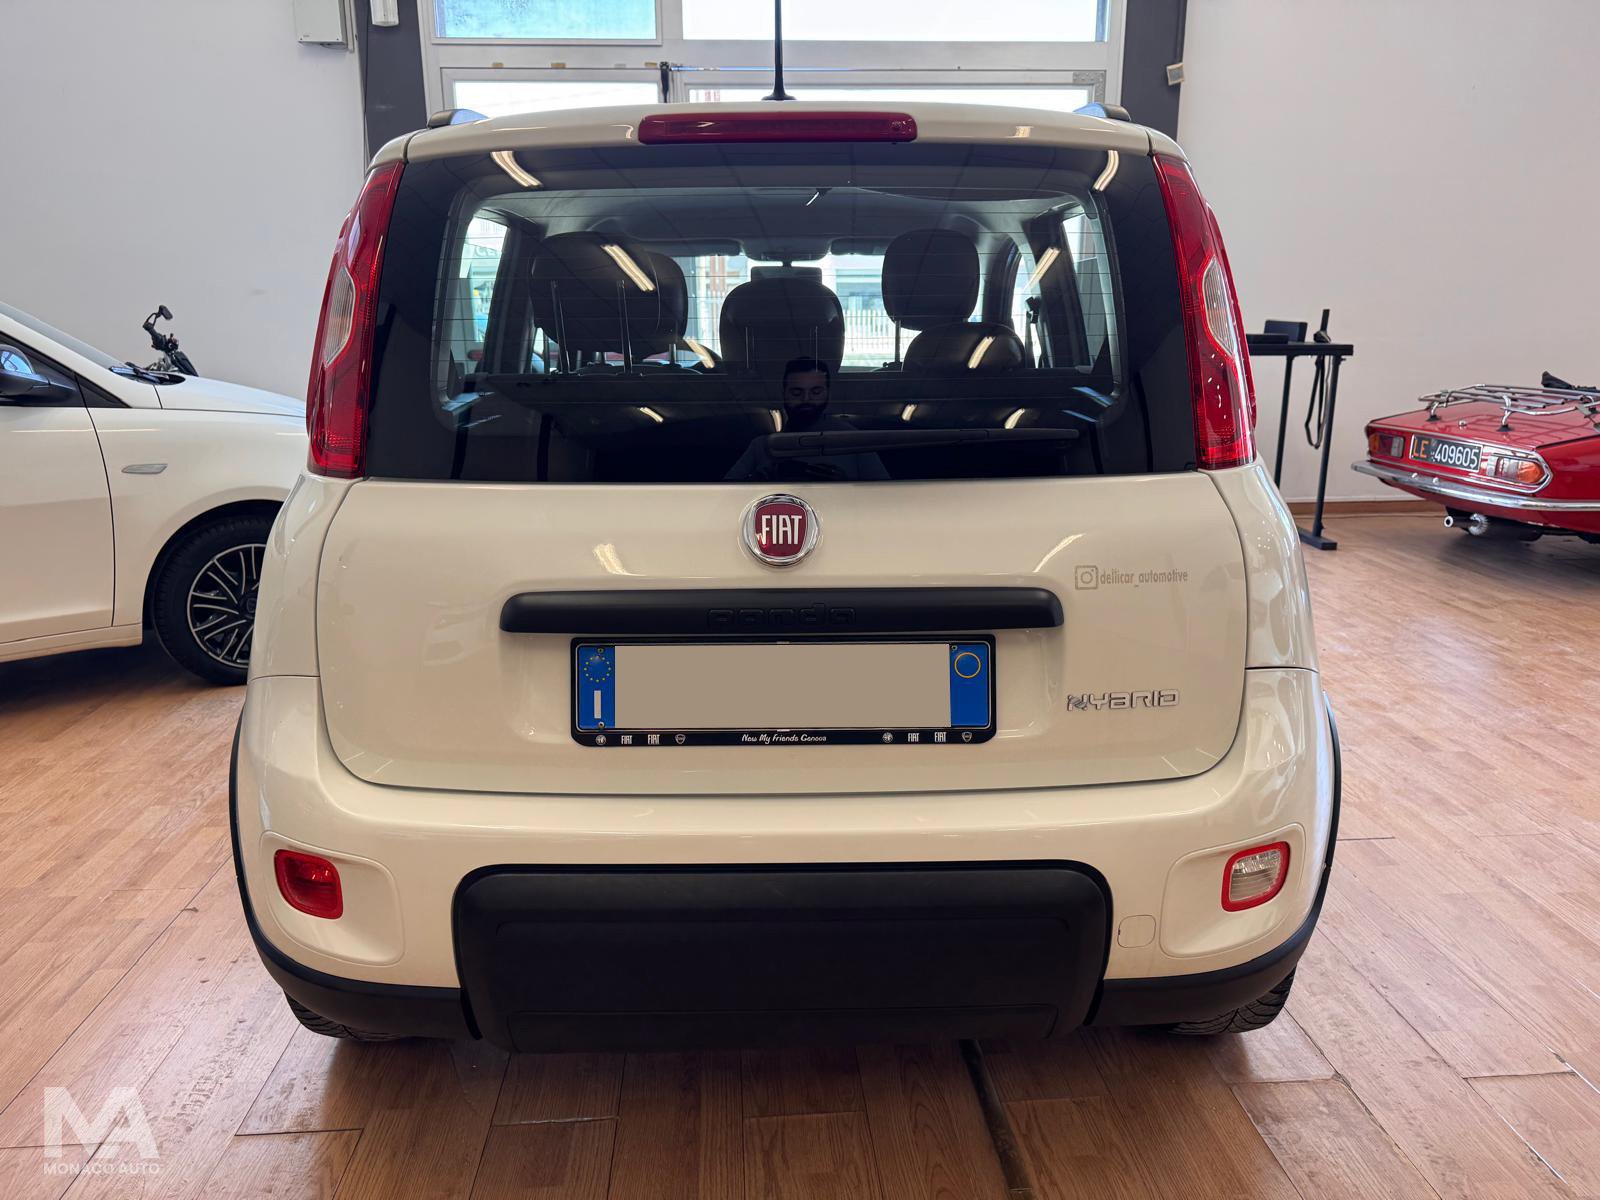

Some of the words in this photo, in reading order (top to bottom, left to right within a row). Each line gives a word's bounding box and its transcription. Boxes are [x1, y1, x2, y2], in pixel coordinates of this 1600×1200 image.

[1413, 438, 1429, 458] LE
[1434, 443, 1480, 469] 409605
[761, 514, 803, 545] FIAT
[1067, 689, 1180, 711] HYBRID
[621, 735, 633, 745] FIAT
[647, 734, 660, 745] FIAT
[759, 733, 771, 745] My
[772, 733, 799, 742] Friends
[907, 732, 920, 742] FIAT
[934, 731, 947, 743] FIAT
